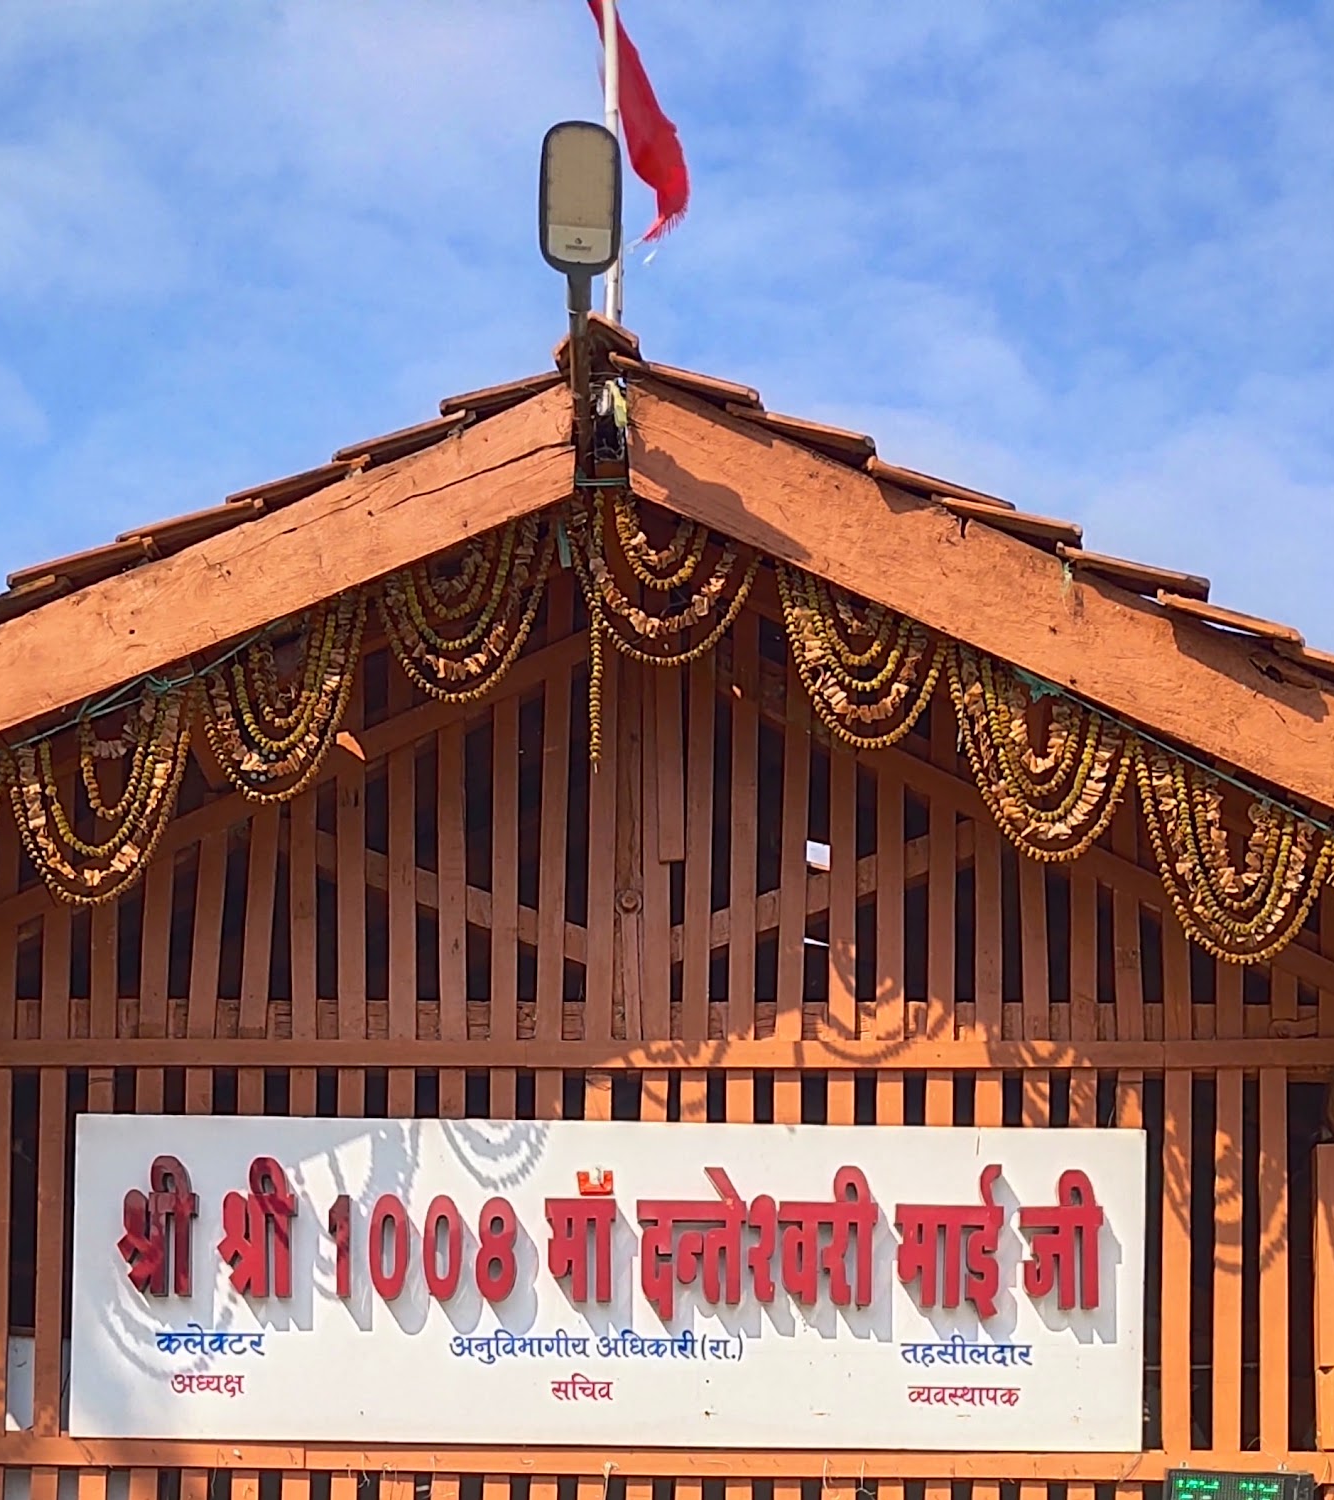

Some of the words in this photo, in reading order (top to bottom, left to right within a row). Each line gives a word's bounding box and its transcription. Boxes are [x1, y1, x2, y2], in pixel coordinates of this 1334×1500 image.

[117, 1155, 199, 1297] श्री
[217, 1157, 298, 1298] श्री
[328, 1193, 517, 1302] 1008
[637, 1165, 878, 1321] दन्तेश्वरी
[894, 1164, 1004, 1319] माई
[1018, 1169, 1103, 1310] जी
[155, 1323, 265, 1356] कलेक्टर
[449, 1328, 590, 1364] अनुविभागीय
[900, 1334, 1033, 1367] तहसीलदार
[170, 1374, 245, 1397] अध्यक्ष
[551, 1373, 613, 1401] सचिव
[907, 1385, 1021, 1407] व्यवस्थापक
